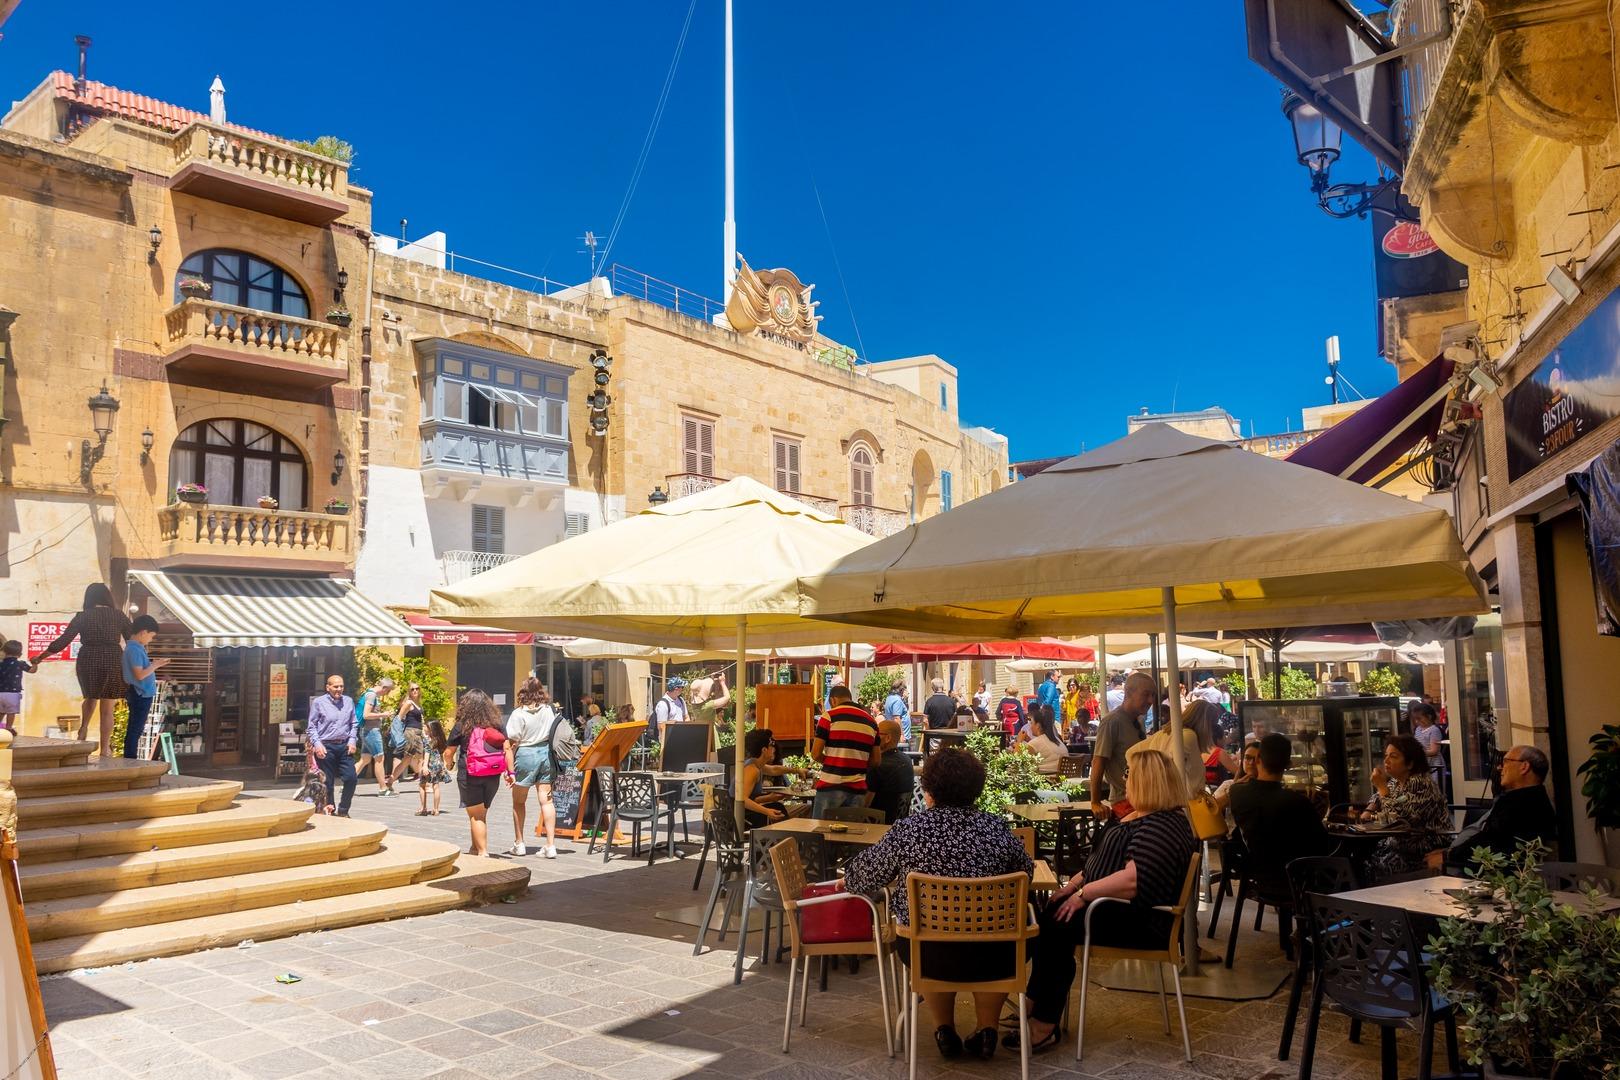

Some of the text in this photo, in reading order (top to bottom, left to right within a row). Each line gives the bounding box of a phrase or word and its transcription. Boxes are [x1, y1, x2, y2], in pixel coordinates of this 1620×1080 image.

[1543, 393, 1574, 434] BISTRO
[31, 625, 57, 634] FOR
[433, 633, 456, 643] Liqueur
